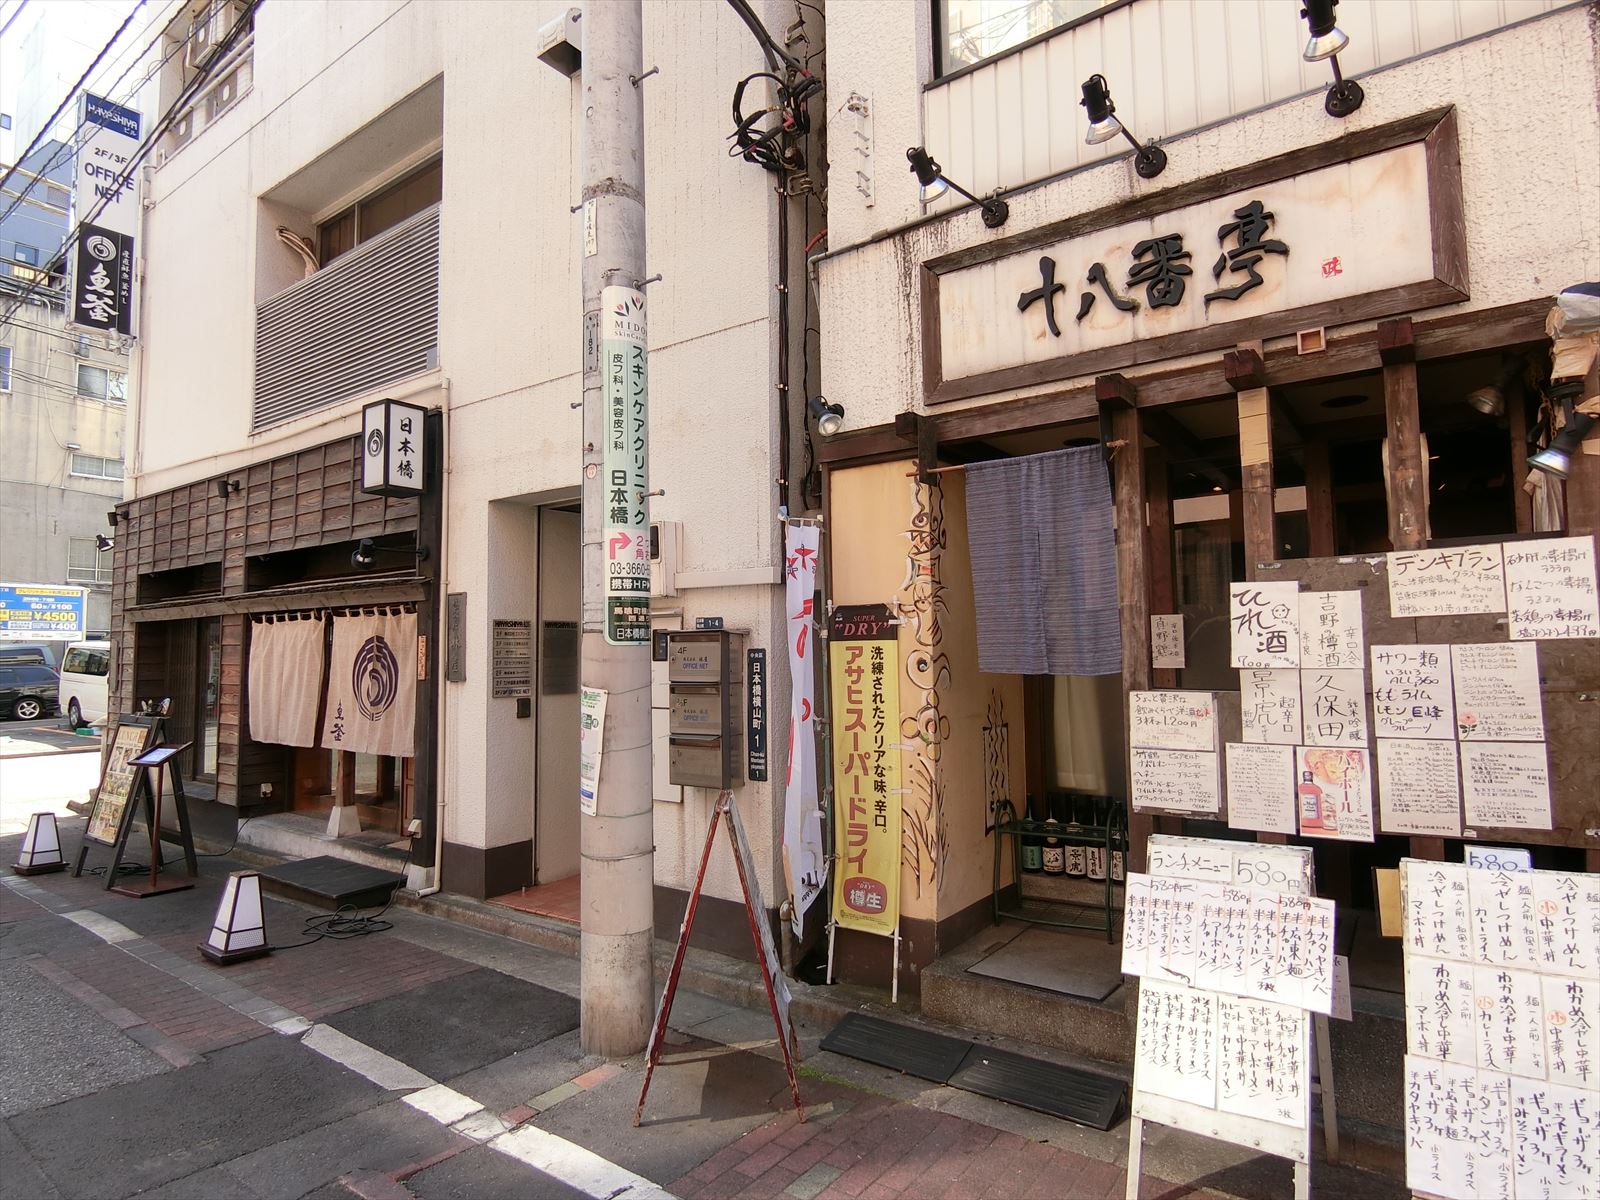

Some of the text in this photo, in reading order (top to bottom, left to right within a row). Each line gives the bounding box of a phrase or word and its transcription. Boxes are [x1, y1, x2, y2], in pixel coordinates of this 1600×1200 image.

[94, 147, 128, 164] 2F/3F
[94, 183, 123, 204] NET
[612, 353, 625, 452] 皮フ科・美容皮フ科
[397, 416, 415, 479] 日本橋
[610, 469, 629, 525] 日本橋
[1395, 549, 1501, 575] デンキブラン
[34, 611, 76, 621] ¥4500
[51, 622, 77, 631] ¥400
[1317, 592, 1342, 668] 吉野の樽酒
[677, 646, 687, 655] 4F
[683, 662, 709, 670] OFFICE NET
[1377, 650, 1439, 669] サワー類
[752, 662, 763, 731] 日本橋横山町
[1250, 670, 1279, 726] 景虎
[1279, 695, 1296, 733] 超辛口
[1313, 674, 1348, 741] 久保田
[1374, 687, 1433, 702] もも ライム
[1377, 705, 1445, 721] レモン 巨峰
[754, 734, 760, 748] 1
[844, 645, 871, 874] アサヒスーパードライ
[871, 645, 887, 834] 洗練されたクリアな味、辛口。
[1339, 755, 1354, 814] ハイボール
[1152, 850, 1230, 872] ランチメニュー
[1237, 858, 1301, 891] 580円
[850, 889, 882, 909] 樽生
[1428, 870, 1450, 954] 冷やしつけめん
[1490, 871, 1519, 961] 冷やしつけめん
[1556, 877, 1587, 969] 冷やしつけめん
[1497, 972, 1517, 1065] わかめ冷やし中華
[1566, 981, 1592, 1082] わかめ冷やし中華
